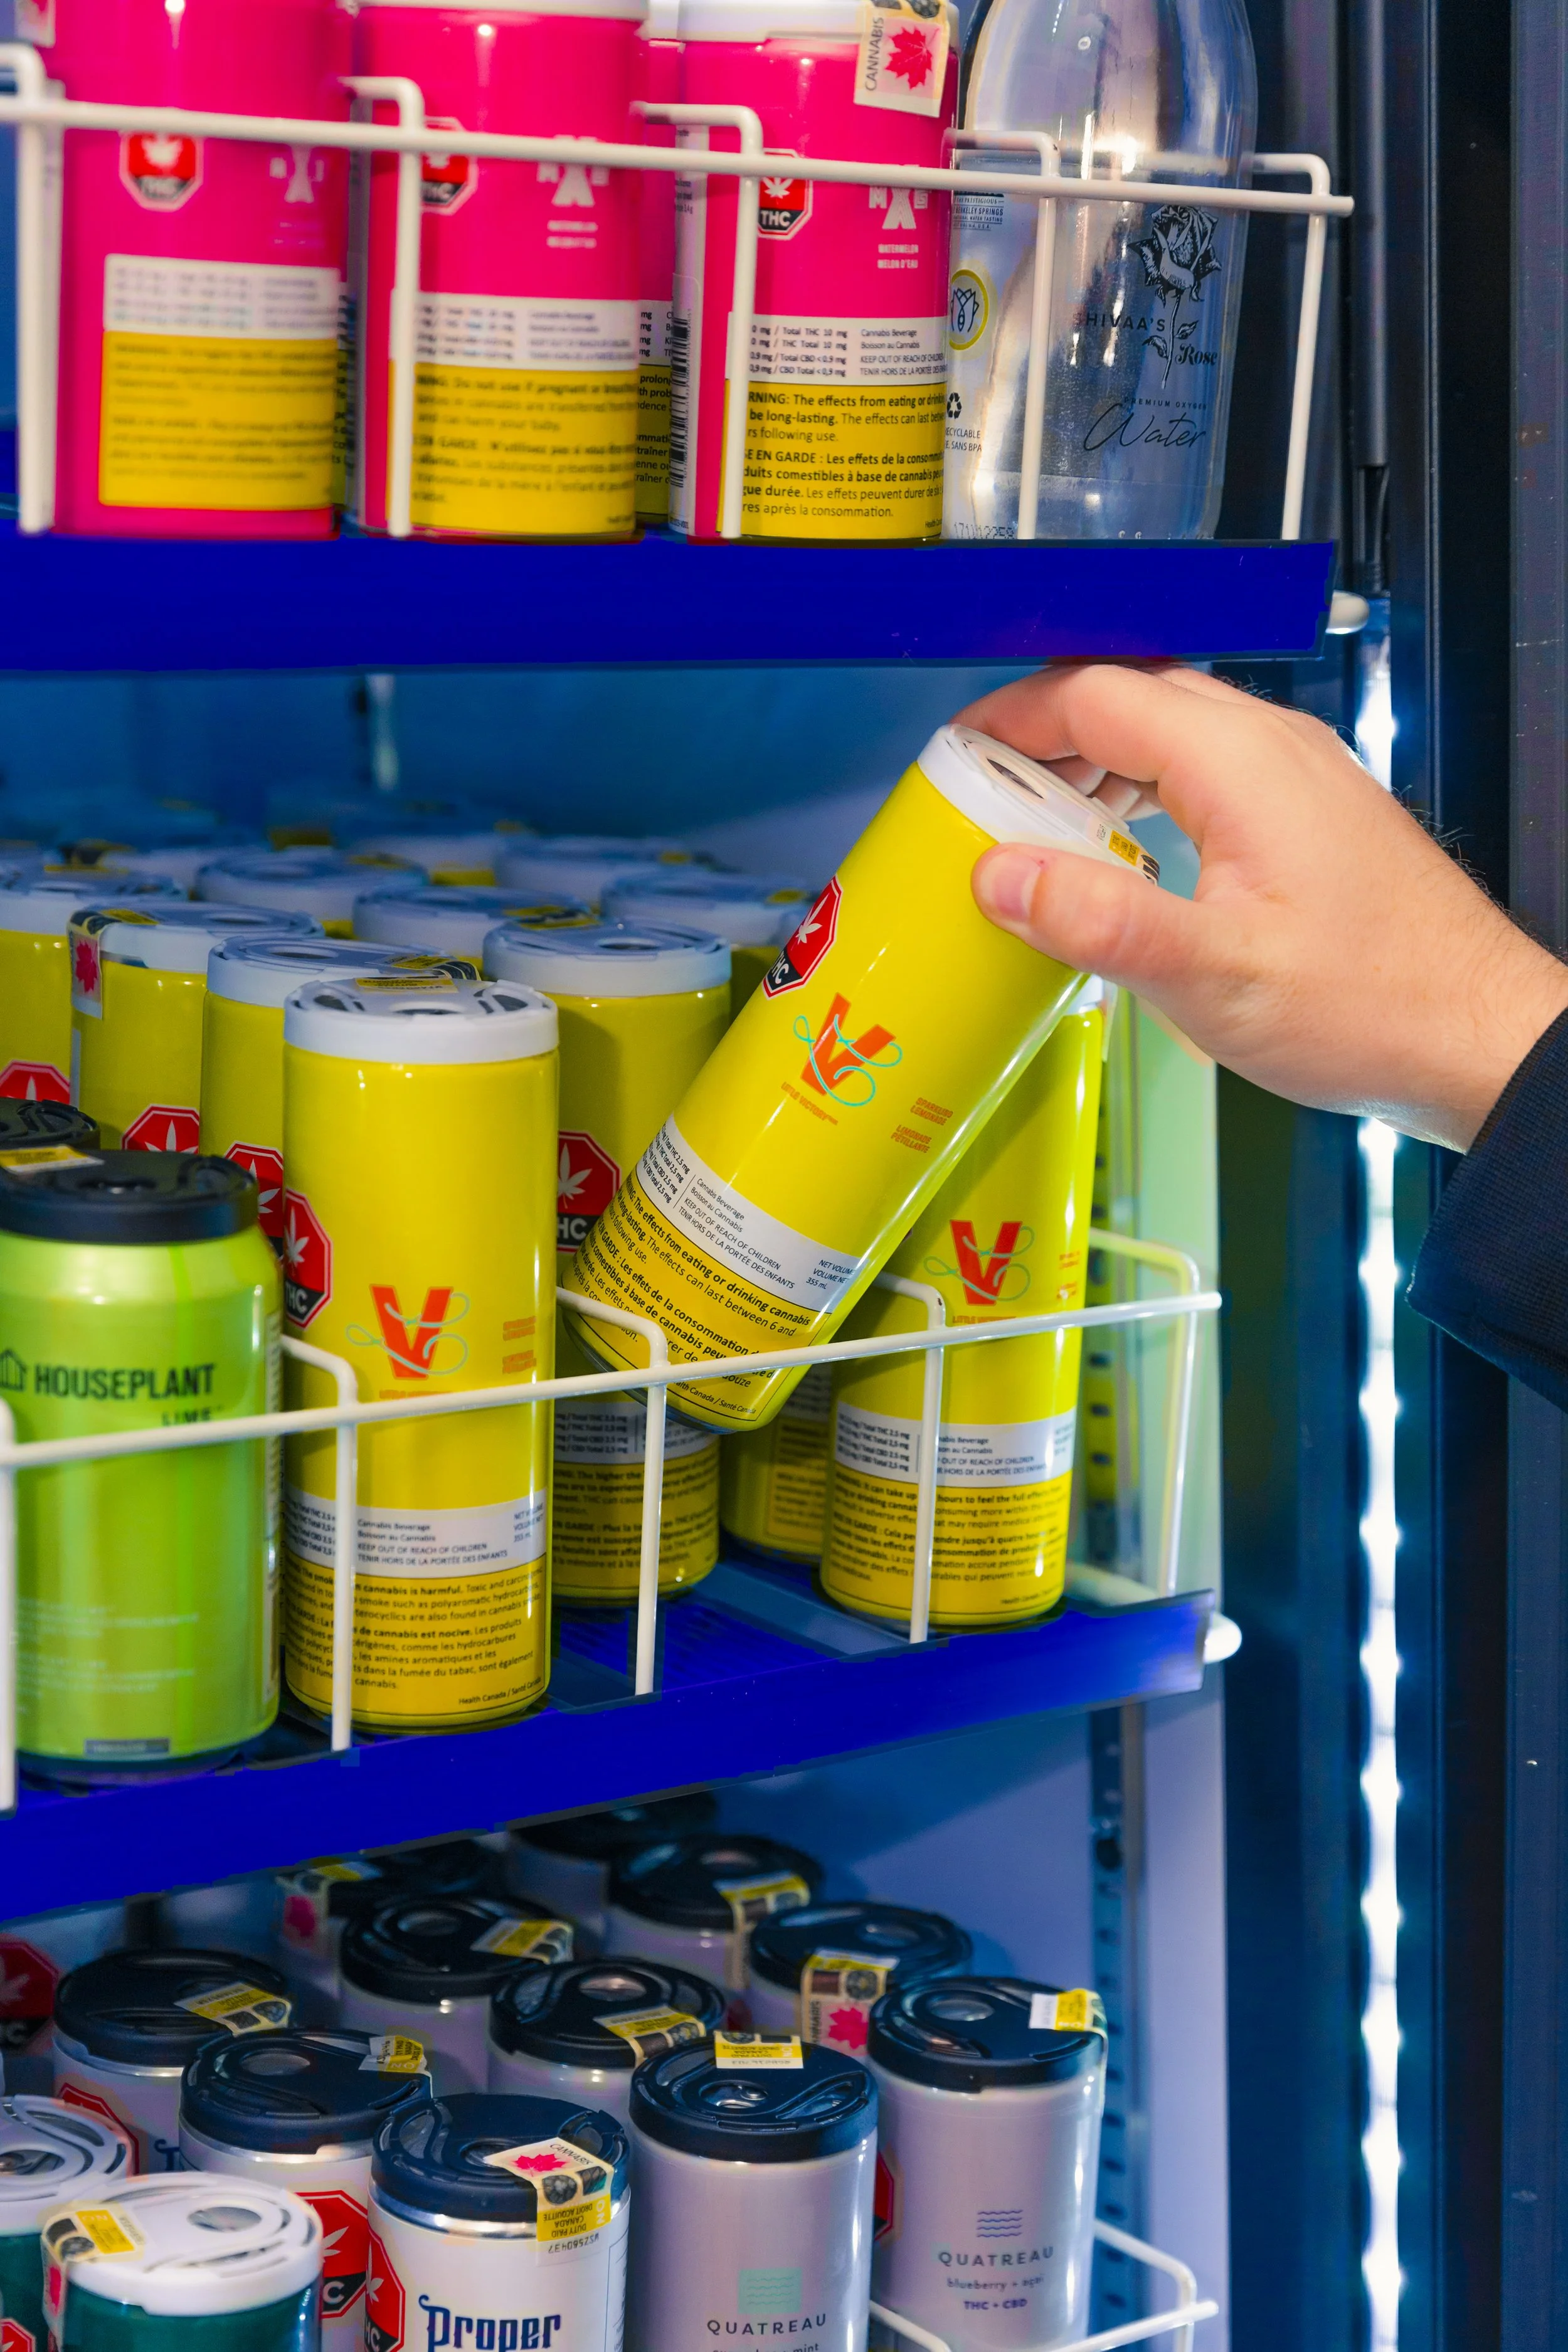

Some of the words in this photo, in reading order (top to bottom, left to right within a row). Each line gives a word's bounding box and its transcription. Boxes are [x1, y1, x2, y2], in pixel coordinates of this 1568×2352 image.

[865, 17, 885, 92] CANNABIS
[760, 210, 791, 227] THC
[978, 208, 1004, 216] SPRINGS
[1073, 312, 1165, 332] SHIVAA'S
[1175, 343, 1218, 366] Rose
[793, 394, 814, 406] The
[818, 395, 856, 407] effects
[860, 395, 886, 407] from
[889, 396, 916, 409] eating
[750, 409, 763, 421] be
[766, 410, 839, 426] long-lasting.
[842, 413, 862, 425] The
[865, 412, 899, 425] effects
[901, 415, 916, 425] can
[1084, 403, 1207, 451] Water
[760, 426, 813, 443] following
[816, 433, 839, 442] use.
[951, 440, 967, 451] SANS
[968, 443, 982, 452] BPA
[756, 450, 772, 461] EN
[775, 451, 817, 464] GARDE
[827, 453, 845, 464] Les
[848, 453, 879, 465] effets
[882, 453, 894, 464] de
[896, 453, 905, 464] la
[776, 470, 844, 482] comestibles
[857, 470, 881, 482] base
[885, 470, 897, 482] de
[899, 468, 932, 481] cannabis
[765, 485, 804, 498] durée.
[807, 487, 824, 499] Les
[827, 487, 857, 500] effets
[860, 489, 902, 502] peuvent
[904, 486, 924, 499] durer
[763, 502, 796, 516] après
[799, 504, 808, 515] la
[812, 506, 894, 518] consommation.
[910, 1105, 948, 1126] LEMONADE
[896, 1124, 932, 1145] LIMONADE
[691, 1187, 708, 1205] Boisson
[707, 1202, 715, 1211] au
[714, 1209, 743, 1232] Cannabis
[697, 1178, 717, 1199] Cannabis
[716, 1195, 744, 1221] Beverage
[558, 1217, 588, 1240] HC
[684, 1197, 696, 1209] KEEP
[695, 1207, 706, 1219] OUT
[705, 1216, 716, 1226] OF
[714, 1223, 738, 1244] REACH
[737, 1241, 748, 1249] OF
[748, 1248, 781, 1270] CHILDREN
[635, 1246, 647, 1264] use.
[679, 1206, 692, 1222] TENIR
[691, 1218, 706, 1233] HORS
[705, 1230, 715, 1241] DE
[715, 1238, 724, 1248] LA
[724, 1245, 750, 1266] PORTÉE
[751, 1263, 764, 1274] DES
[764, 1270, 795, 1289] ENFANTS
[632, 1196, 644, 1214] The
[643, 1210, 664, 1238] effects
[664, 1233, 682, 1253] from
[681, 1249, 712, 1279] eating
[713, 1274, 726, 1285] or
[726, 1283, 769, 1312] drinking
[769, 1306, 811, 1325] cannabis
[818, 1259, 833, 1268] NET
[806, 1277, 819, 1286] 355
[813, 1268, 839, 1283] VOLUME
[594, 1272, 605, 1290] Les
[604, 1286, 623, 1309] effets
[647, 1236, 662, 1254] The
[660, 1248, 686, 1276] effects
[686, 1274, 704, 1290] can
[704, 1285, 724, 1304] last
[724, 1298, 768, 1327] between
[769, 1322, 778, 1330] 6
[777, 1327, 797, 1337] and
[620, 1258, 632, 1275] Les
[632, 1272, 652, 1293] effets
[650, 1289, 664, 1303] de
[663, 1298, 674, 1311] la
[674, 1306, 749, 1355] consommation
[623, 1283, 631, 1293] à
[628, 1288, 645, 1308] base
[645, 1305, 658, 1318] de
[659, 1315, 704, 1349] cannabis
[34, 1362, 215, 1401] HOUSEPLANT
[689, 1387, 715, 1403] Canada
[719, 1399, 738, 1411] Santé
[363, 1584, 407, 1596] cannabis
[420, 1586, 464, 1596] harmful.
[467, 1584, 487, 1594] Toxic
[489, 1580, 504, 1590] and
[392, 1597, 415, 1608] such
[431, 1595, 491, 1609] polyaromatic
[450, 1609, 477, 1620] found
[374, 1627, 418, 1640] cannabis
[439, 1629, 473, 1639] nocive.
[490, 1618, 522, 1634] produits
[401, 1643, 438, 1652] comme
[457, 1632, 517, 1650] hydrocarbures
[374, 1654, 410, 1664] amines
[412, 1653, 472, 1668] aromatiques
[400, 1665, 432, 1677] fumée
[449, 1665, 477, 1676] tabac,
[499, 1650, 534, 1670] également
[458, 1695, 481, 1705] Health
[482, 1690, 507, 1703] Canada
[549, 2144, 594, 2166] CANNABIS
[576, 2203, 593, 2215] DROIT
[596, 2199, 606, 2225] ON
[554, 2216, 585, 2228] CANADA
[569, 2223, 586, 2235] DUTY
[551, 2228, 568, 2238] PAID
[938, 2246, 1054, 2267] QUATREAU
[947, 2277, 1007, 2292] blueberry
[963, 2301, 990, 2310] THC
[1002, 2299, 1028, 2310] CBD
[418, 2294, 561, 2352] Proper
[707, 2313, 827, 2336] QUATREAU
[365, 2322, 380, 2352] HC
